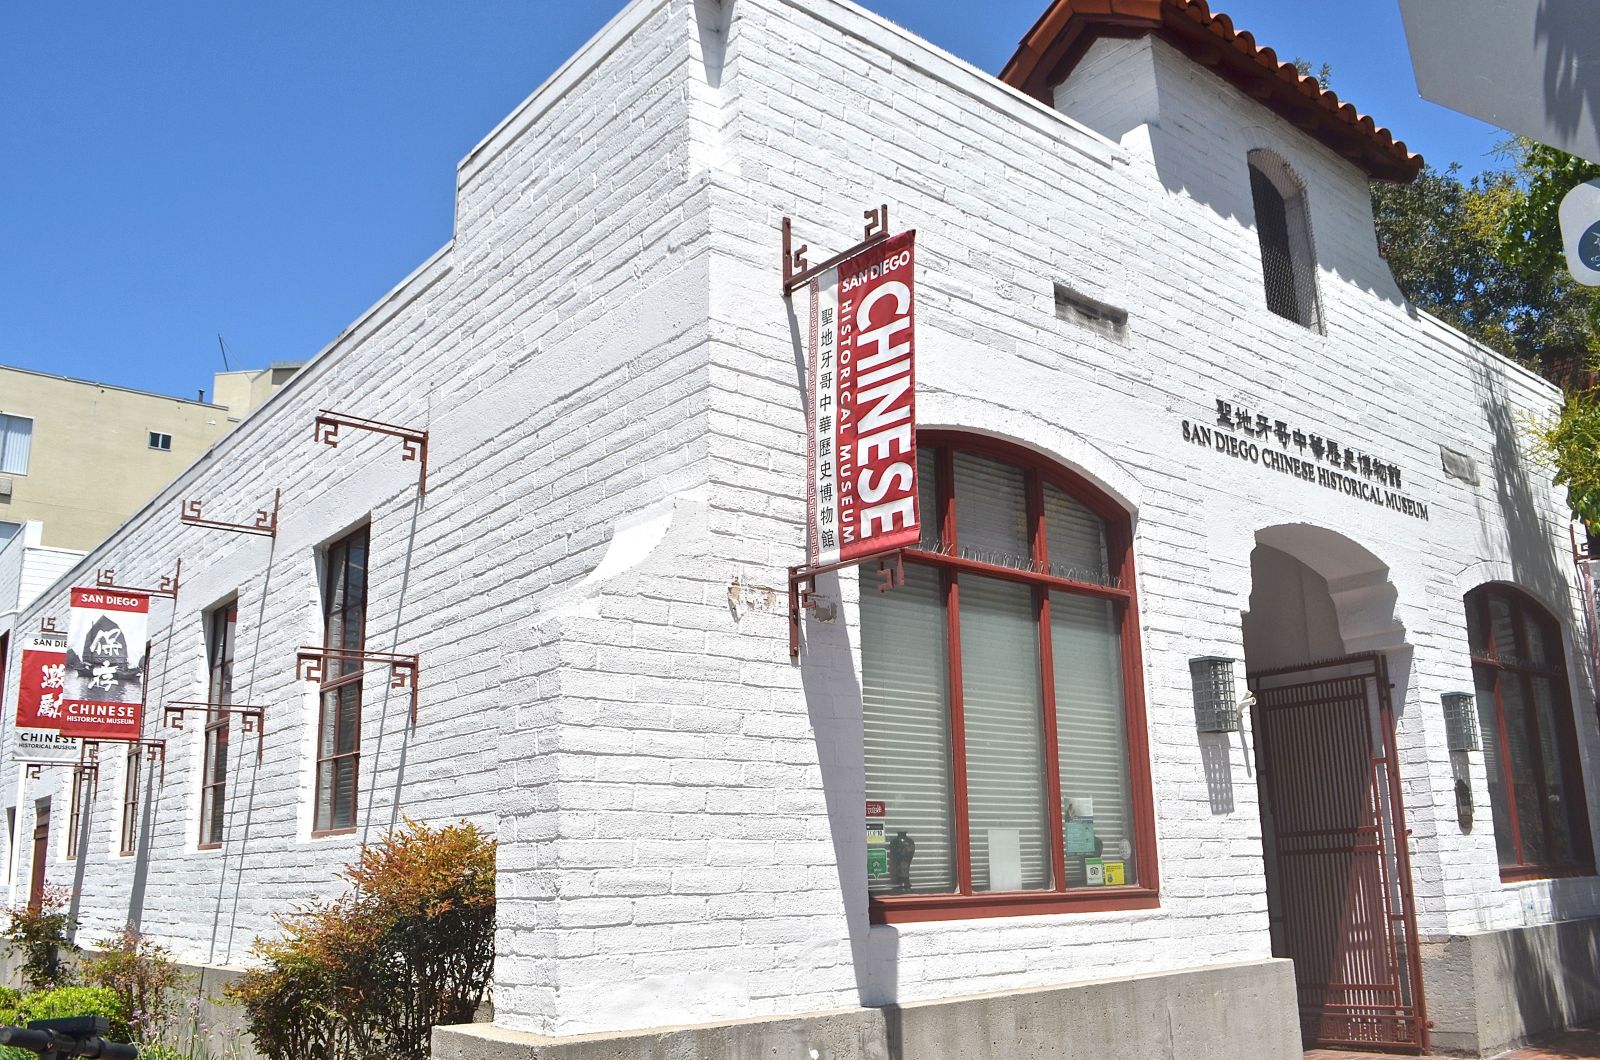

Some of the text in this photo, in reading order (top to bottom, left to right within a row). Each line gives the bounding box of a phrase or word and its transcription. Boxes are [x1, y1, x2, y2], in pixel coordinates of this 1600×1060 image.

[842, 250, 910, 292] SAN DIEGO
[840, 300, 855, 544] HISTORICAL MUSEUM
[857, 281, 916, 539] CHINESE
[819, 308, 835, 549] 聖地牙哥中華歷史博物館
[1216, 398, 1402, 490] 聖地牙哥中華歷史博物館
[1182, 420, 1429, 521] SAN DIEGO CHINESE HISTORICAL MUSEUM
[82, 593, 139, 607] SAN DIEGO
[33, 638, 68, 648] SAN DIE
[66, 715, 135, 725] HISTORICAL MUSEUM
[68, 703, 134, 718] CHINESE
[18, 742, 52, 750] HISTORICAL
[20, 732, 77, 744] CHINESE
